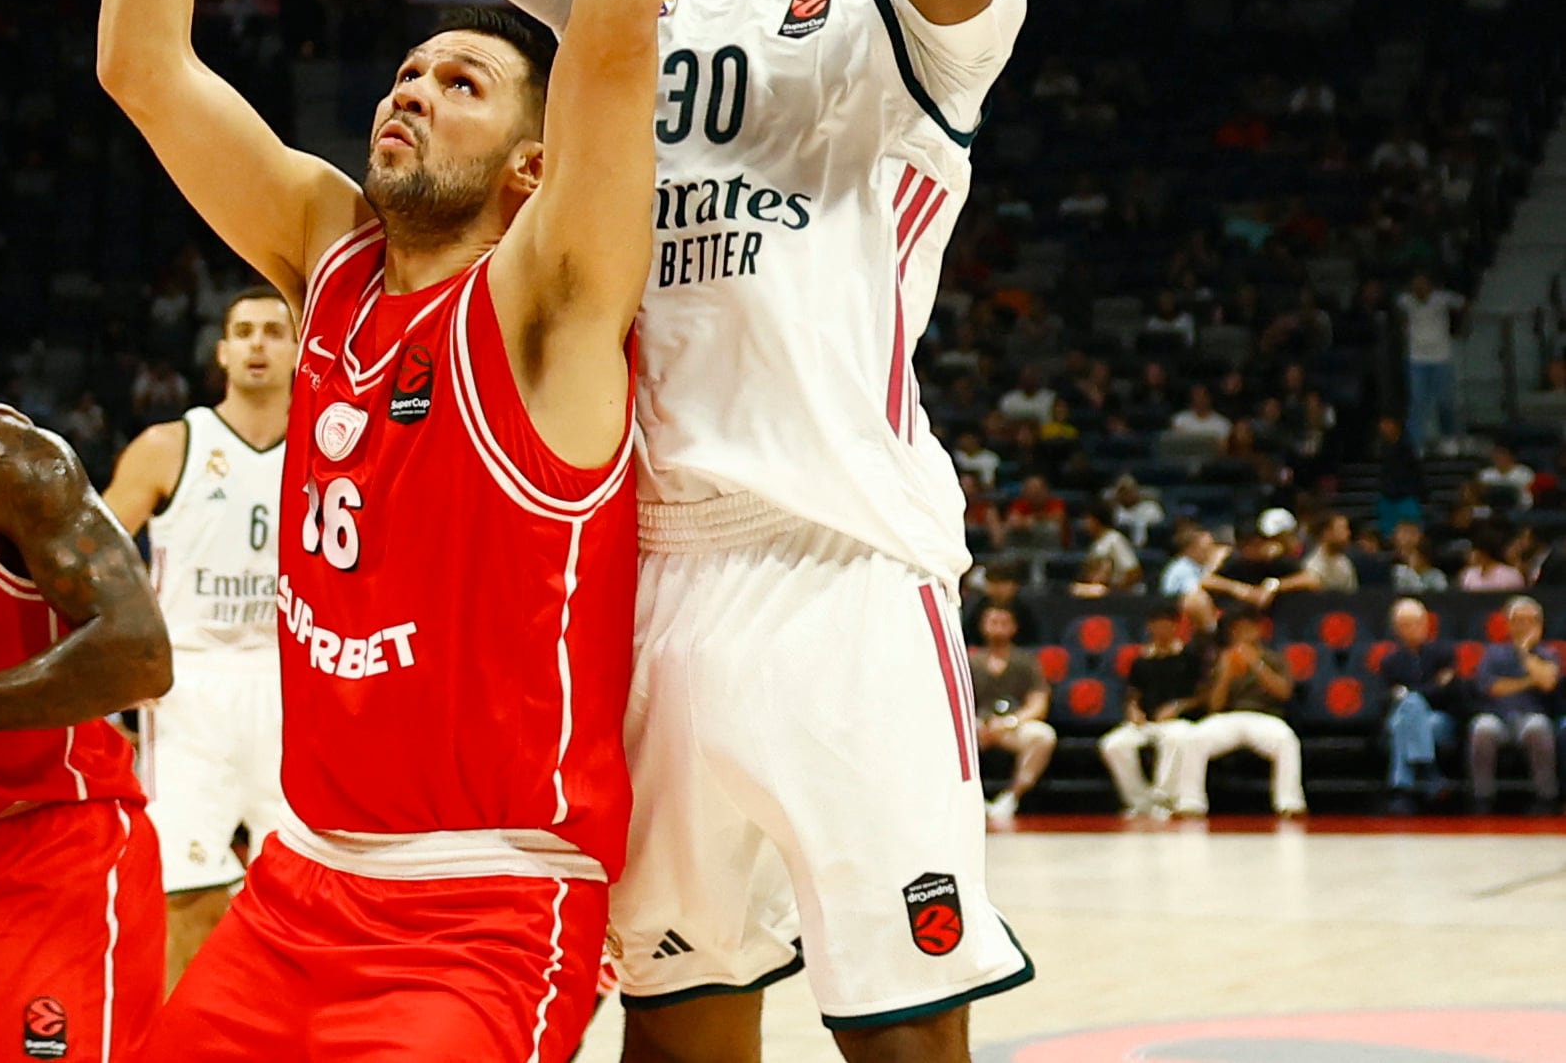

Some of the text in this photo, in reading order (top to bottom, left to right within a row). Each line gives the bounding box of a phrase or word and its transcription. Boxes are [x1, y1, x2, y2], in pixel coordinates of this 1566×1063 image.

[656, 44, 748, 145] 30
[656, 173, 812, 230] irates
[659, 231, 763, 289] BETTER
[249, 504, 270, 551] 6
